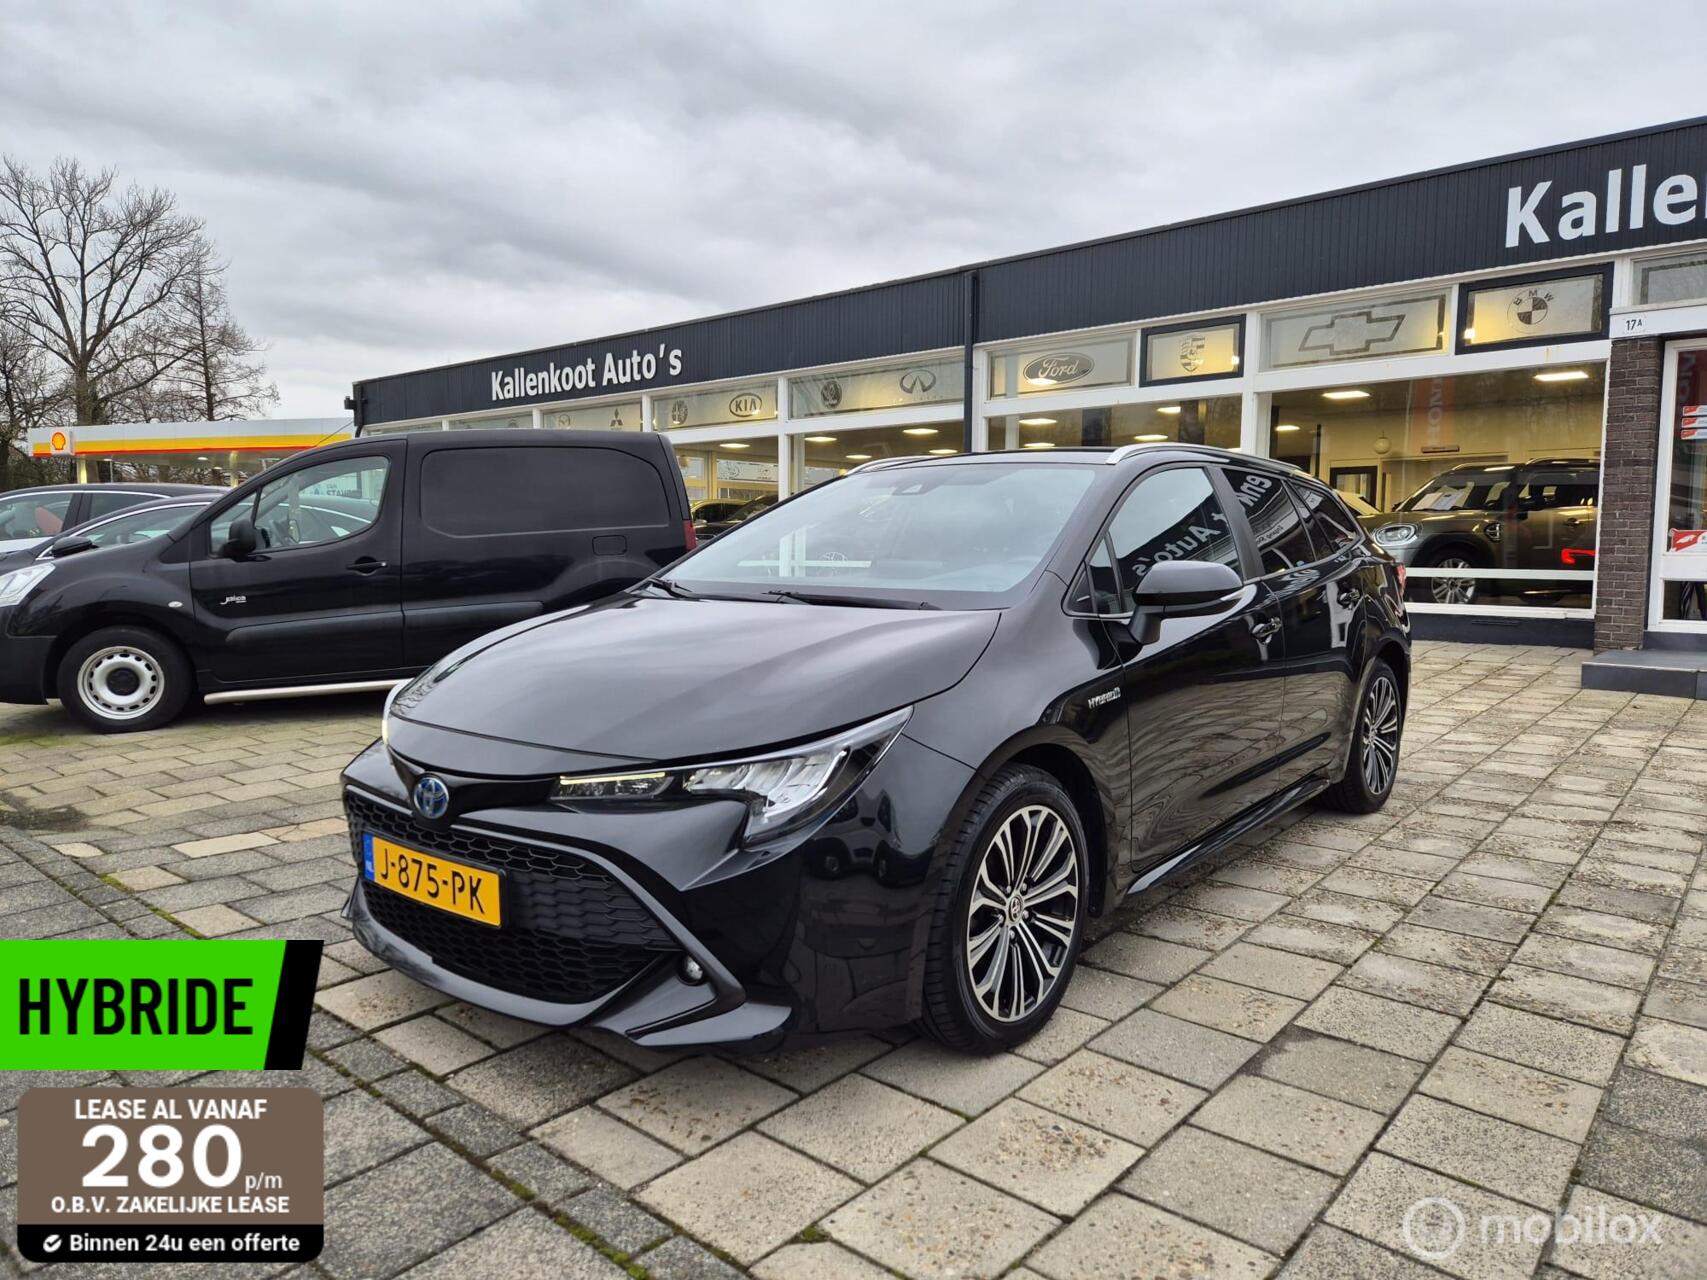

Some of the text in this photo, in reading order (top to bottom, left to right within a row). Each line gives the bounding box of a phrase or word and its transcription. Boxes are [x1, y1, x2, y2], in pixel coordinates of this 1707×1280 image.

[1505, 163, 1707, 248] Kalle
[491, 343, 682, 401] Kallenkoot Auto's
[1038, 357, 1080, 378] Ford
[734, 399, 757, 414] KIA
[381, 848, 485, 914] J-875-PK
